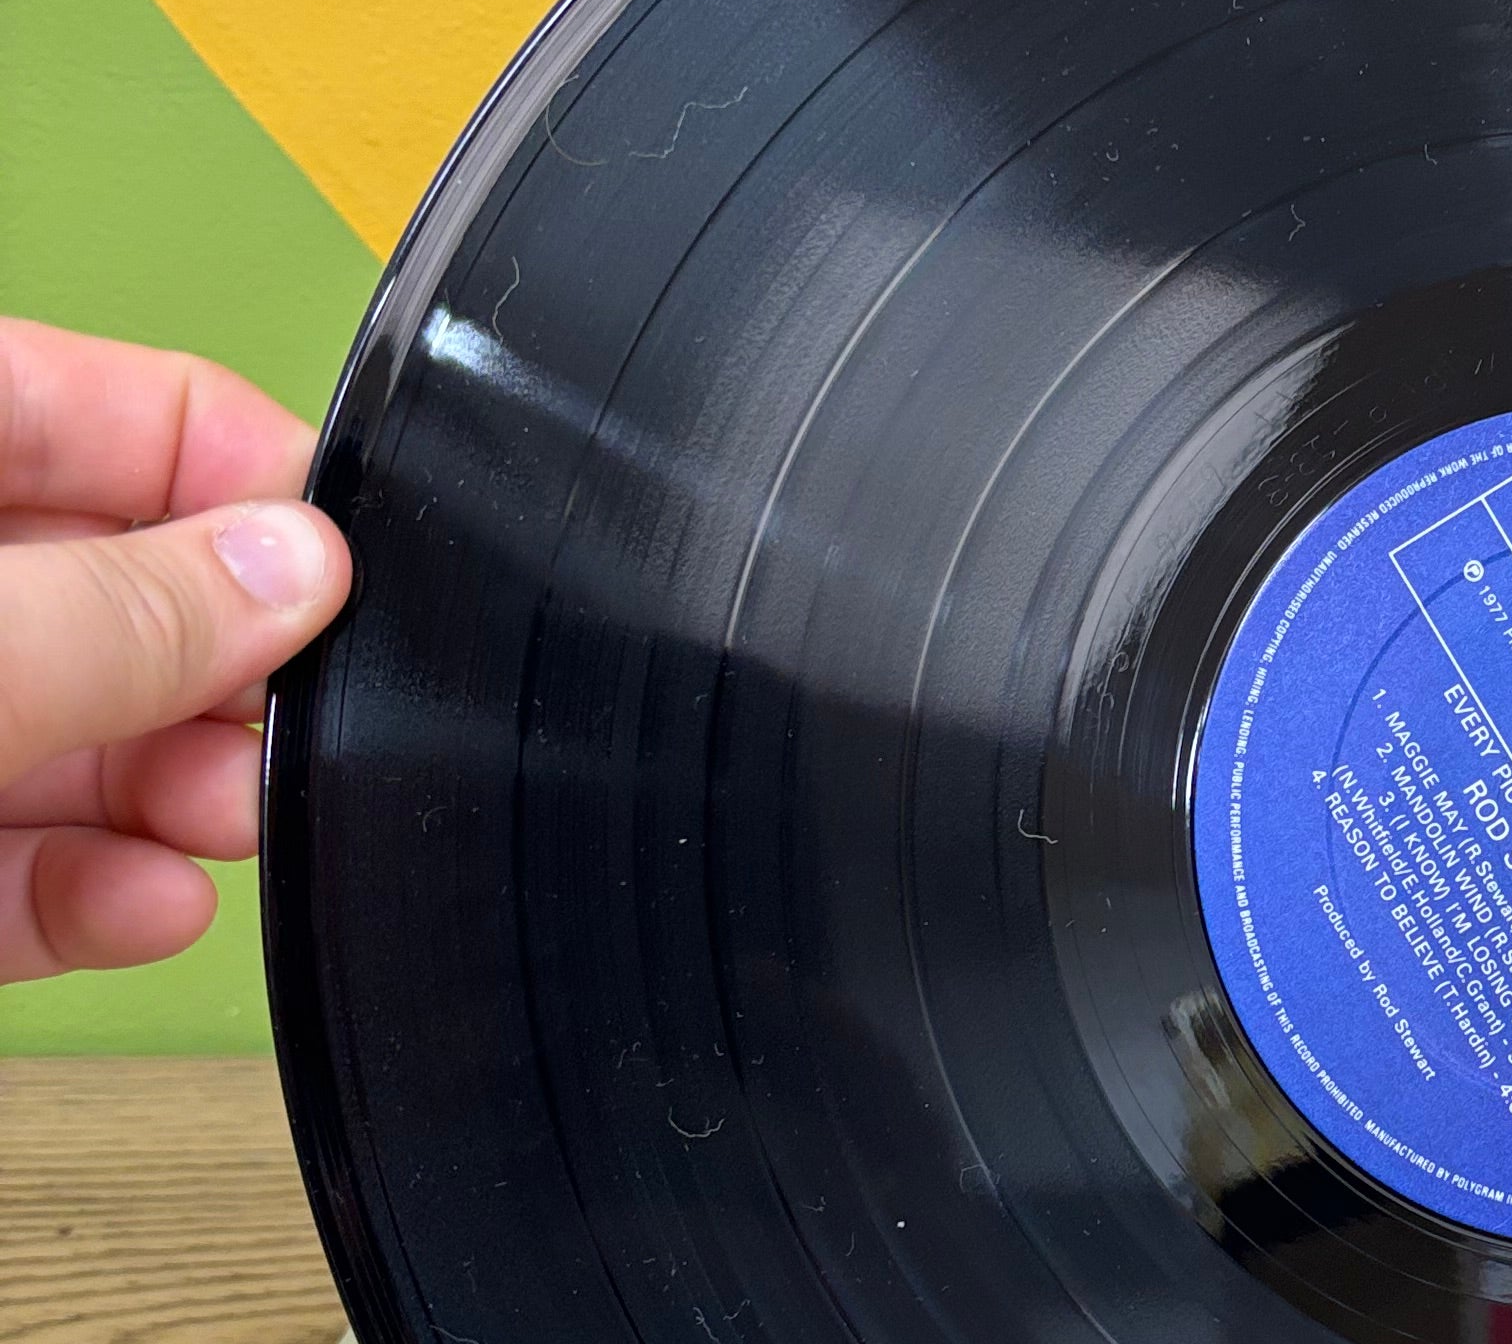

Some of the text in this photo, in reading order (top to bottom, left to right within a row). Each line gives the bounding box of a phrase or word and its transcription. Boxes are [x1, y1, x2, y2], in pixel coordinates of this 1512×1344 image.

[1436, 456, 1470, 479] WORK
[1468, 449, 1490, 467] THE
[1489, 443, 1505, 459] OF
[1377, 470, 1439, 515] REPRODUCED
[1283, 549, 1339, 621] UNAUTHORISED
[1478, 584, 1509, 623] 1977
[1442, 682, 1502, 758] EVERY
[1229, 760, 1246, 801] PUBLIC
[1371, 687, 1388, 710] 1.
[1383, 710, 1441, 791] MAGGIE
[1432, 789, 1470, 834] MAY
[1461, 778, 1511, 842] ROD
[1228, 801, 1246, 883] PERFORMANCE
[1375, 741, 1395, 764] 2.
[1390, 764, 1462, 869] MANDOLIN
[1453, 867, 1494, 925] WIND
[1377, 790, 1396, 814] 3.
[1387, 813, 1411, 832] (I
[1402, 831, 1452, 902] KNOW)
[1444, 901, 1473, 935] I'M
[1233, 884, 1250, 909] AND
[1311, 769, 1328, 791] 4.
[1323, 790, 1381, 873] REASON
[1373, 870, 1398, 902] TO
[1390, 902, 1446, 981] BELIEVE
[1432, 979, 1497, 1070] (T.Hardin)
[1238, 908, 1275, 993] BROADCASTING
[1265, 990, 1283, 1007] OF
[1312, 883, 1437, 1082] Produced by Rod Stewart
[1273, 1006, 1295, 1035] THIS
[1288, 1032, 1322, 1074] RECORD
[1363, 1118, 1437, 1175] MANUFACTURED
[1434, 1165, 1452, 1183] BY
[1450, 1173, 1506, 1203] POLYGRAM
